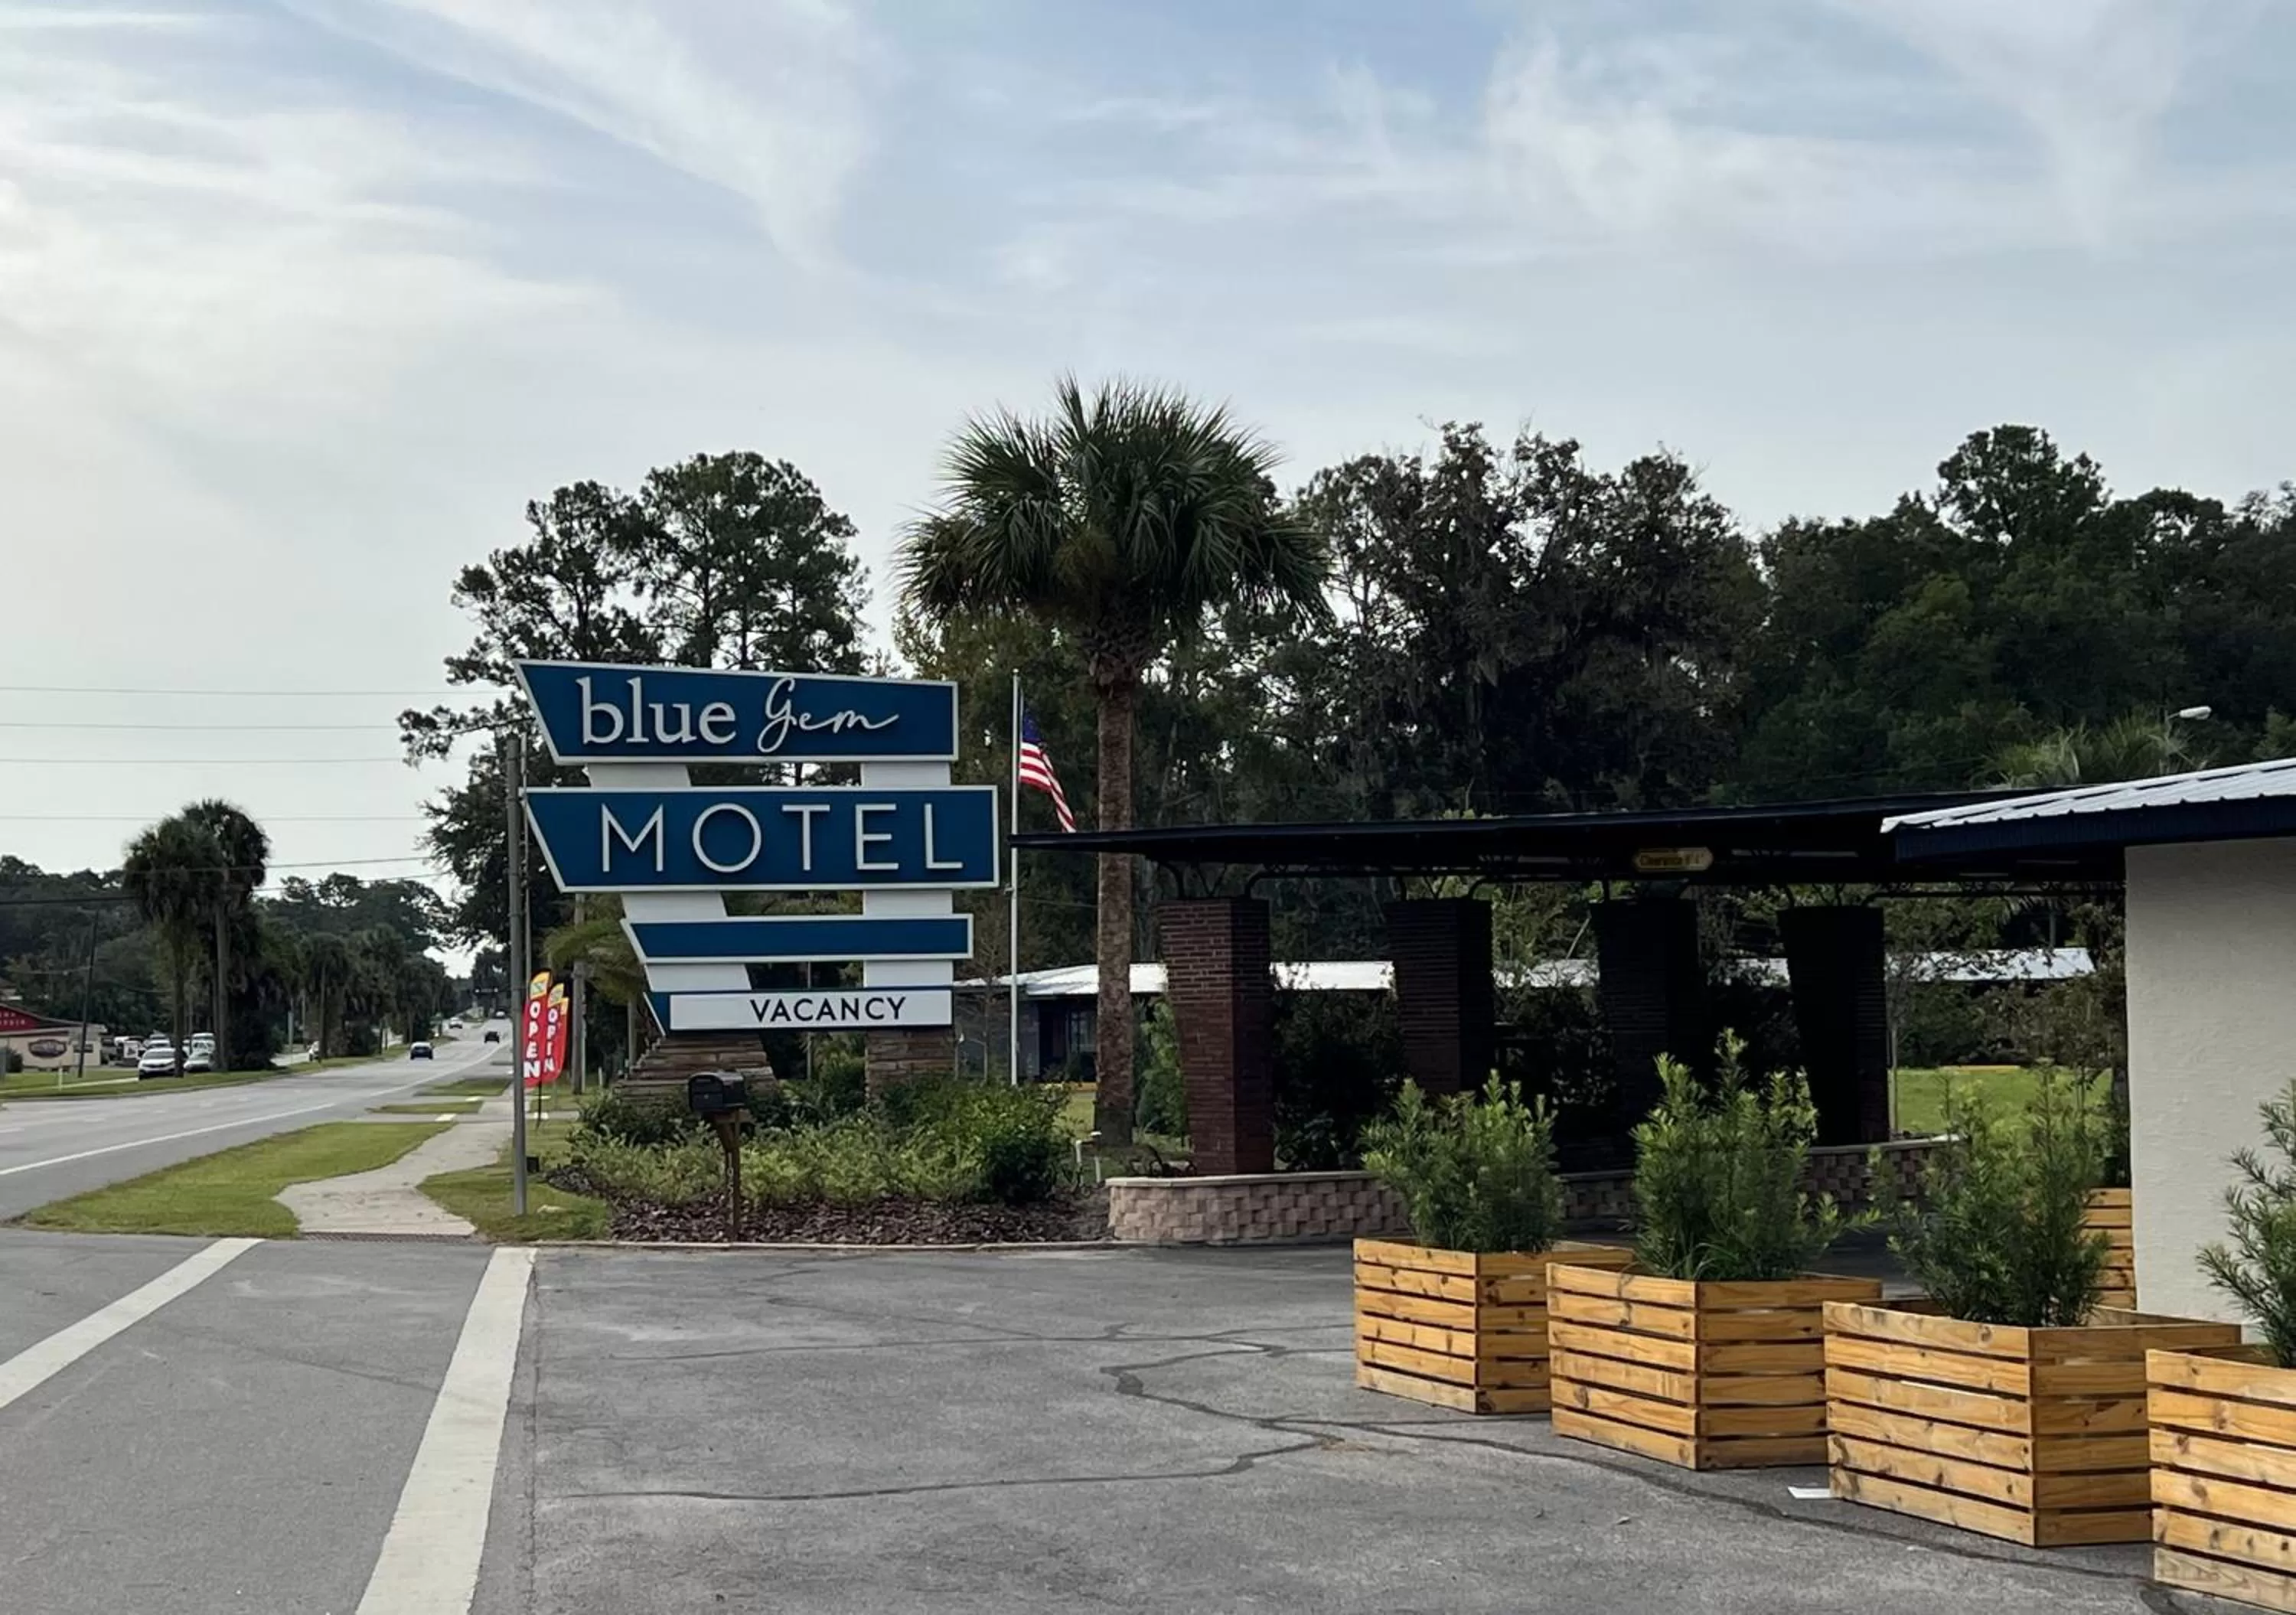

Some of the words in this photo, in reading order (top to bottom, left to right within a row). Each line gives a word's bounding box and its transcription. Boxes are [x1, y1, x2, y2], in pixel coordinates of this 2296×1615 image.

[576, 677, 736, 746] blue
[756, 677, 900, 752] Gem
[602, 803, 964, 873] MOTEL
[523, 1000, 541, 1078] OPEN
[750, 997, 906, 1022] VACANCY
